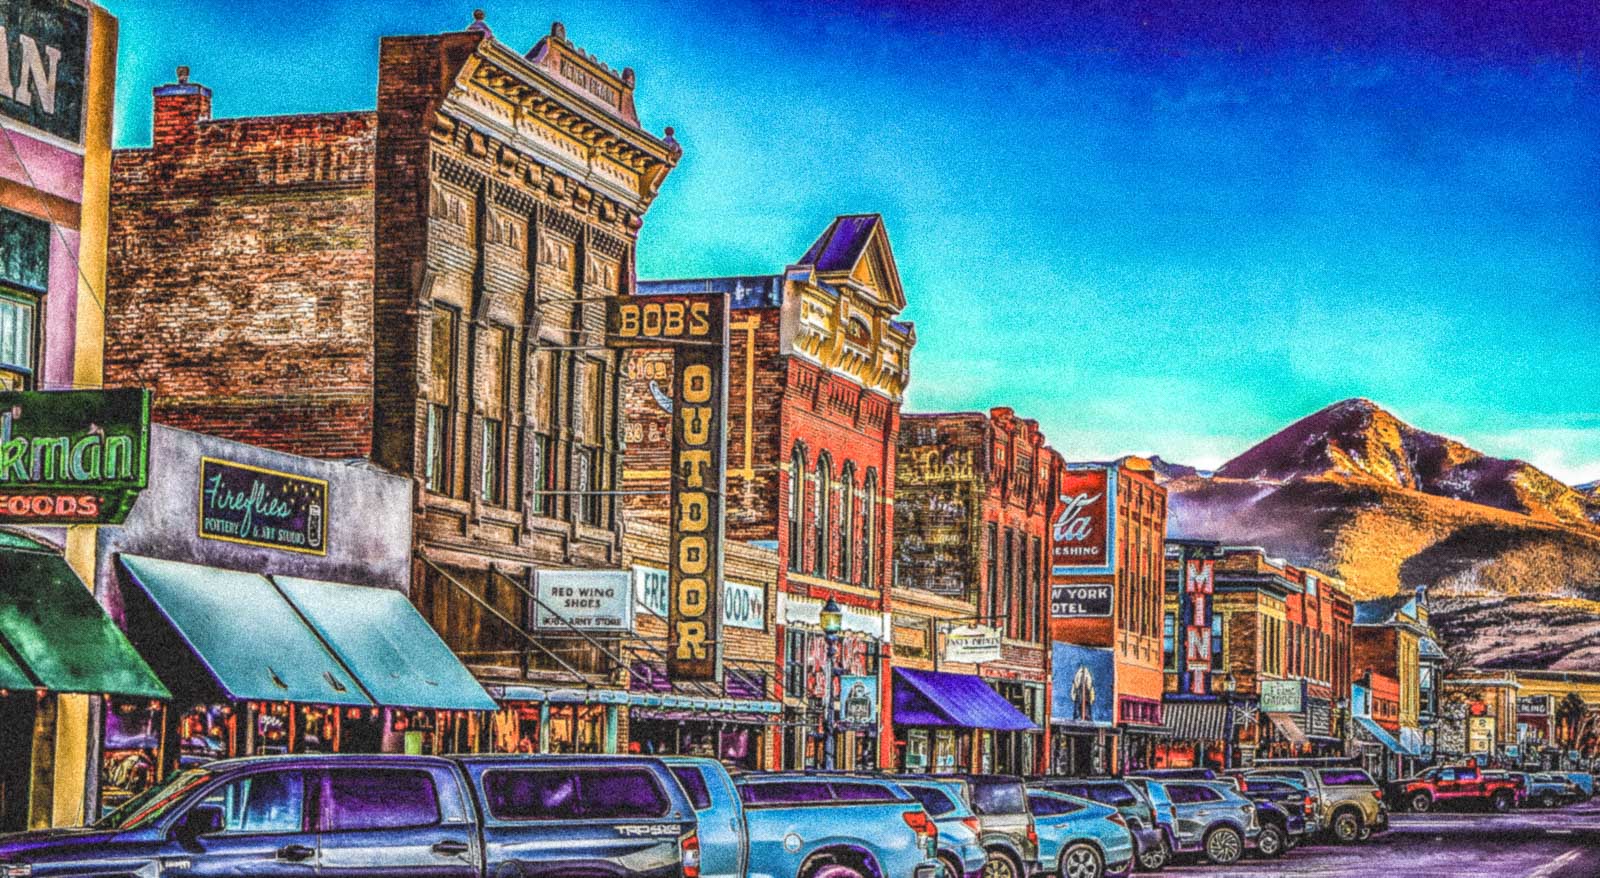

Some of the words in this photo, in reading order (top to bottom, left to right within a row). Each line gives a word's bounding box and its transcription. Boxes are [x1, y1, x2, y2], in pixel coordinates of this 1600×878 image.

[620, 300, 710, 337] BOB'S
[205, 473, 292, 538] Fireflies
[676, 364, 713, 660] OUTDOOR
[205, 517, 239, 534] POTTERY
[1052, 546, 1099, 556] ESHING
[551, 587, 574, 597] RED
[579, 587, 615, 598] WING
[1067, 588, 1108, 599] YORK
[564, 599, 601, 608] SHOES
[595, 617, 622, 626] STORE
[1186, 560, 1215, 695] MINT
